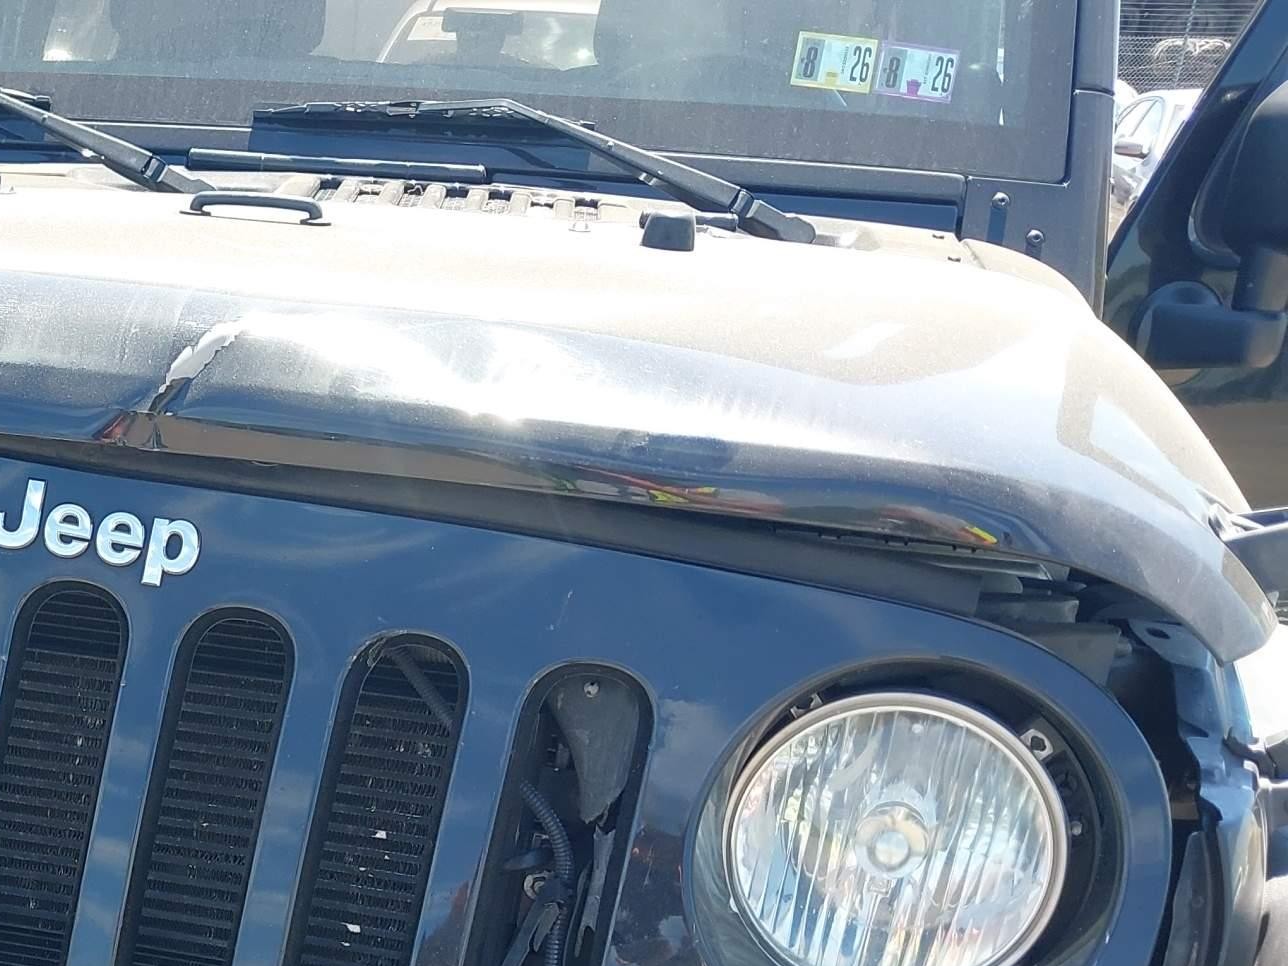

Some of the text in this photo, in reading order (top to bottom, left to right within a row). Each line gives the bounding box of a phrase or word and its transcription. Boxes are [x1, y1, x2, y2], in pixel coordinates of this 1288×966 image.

[802, 46, 819, 78] 8
[849, 45, 872, 82] 26
[885, 56, 901, 88] 8
[931, 55, 955, 93] 26
